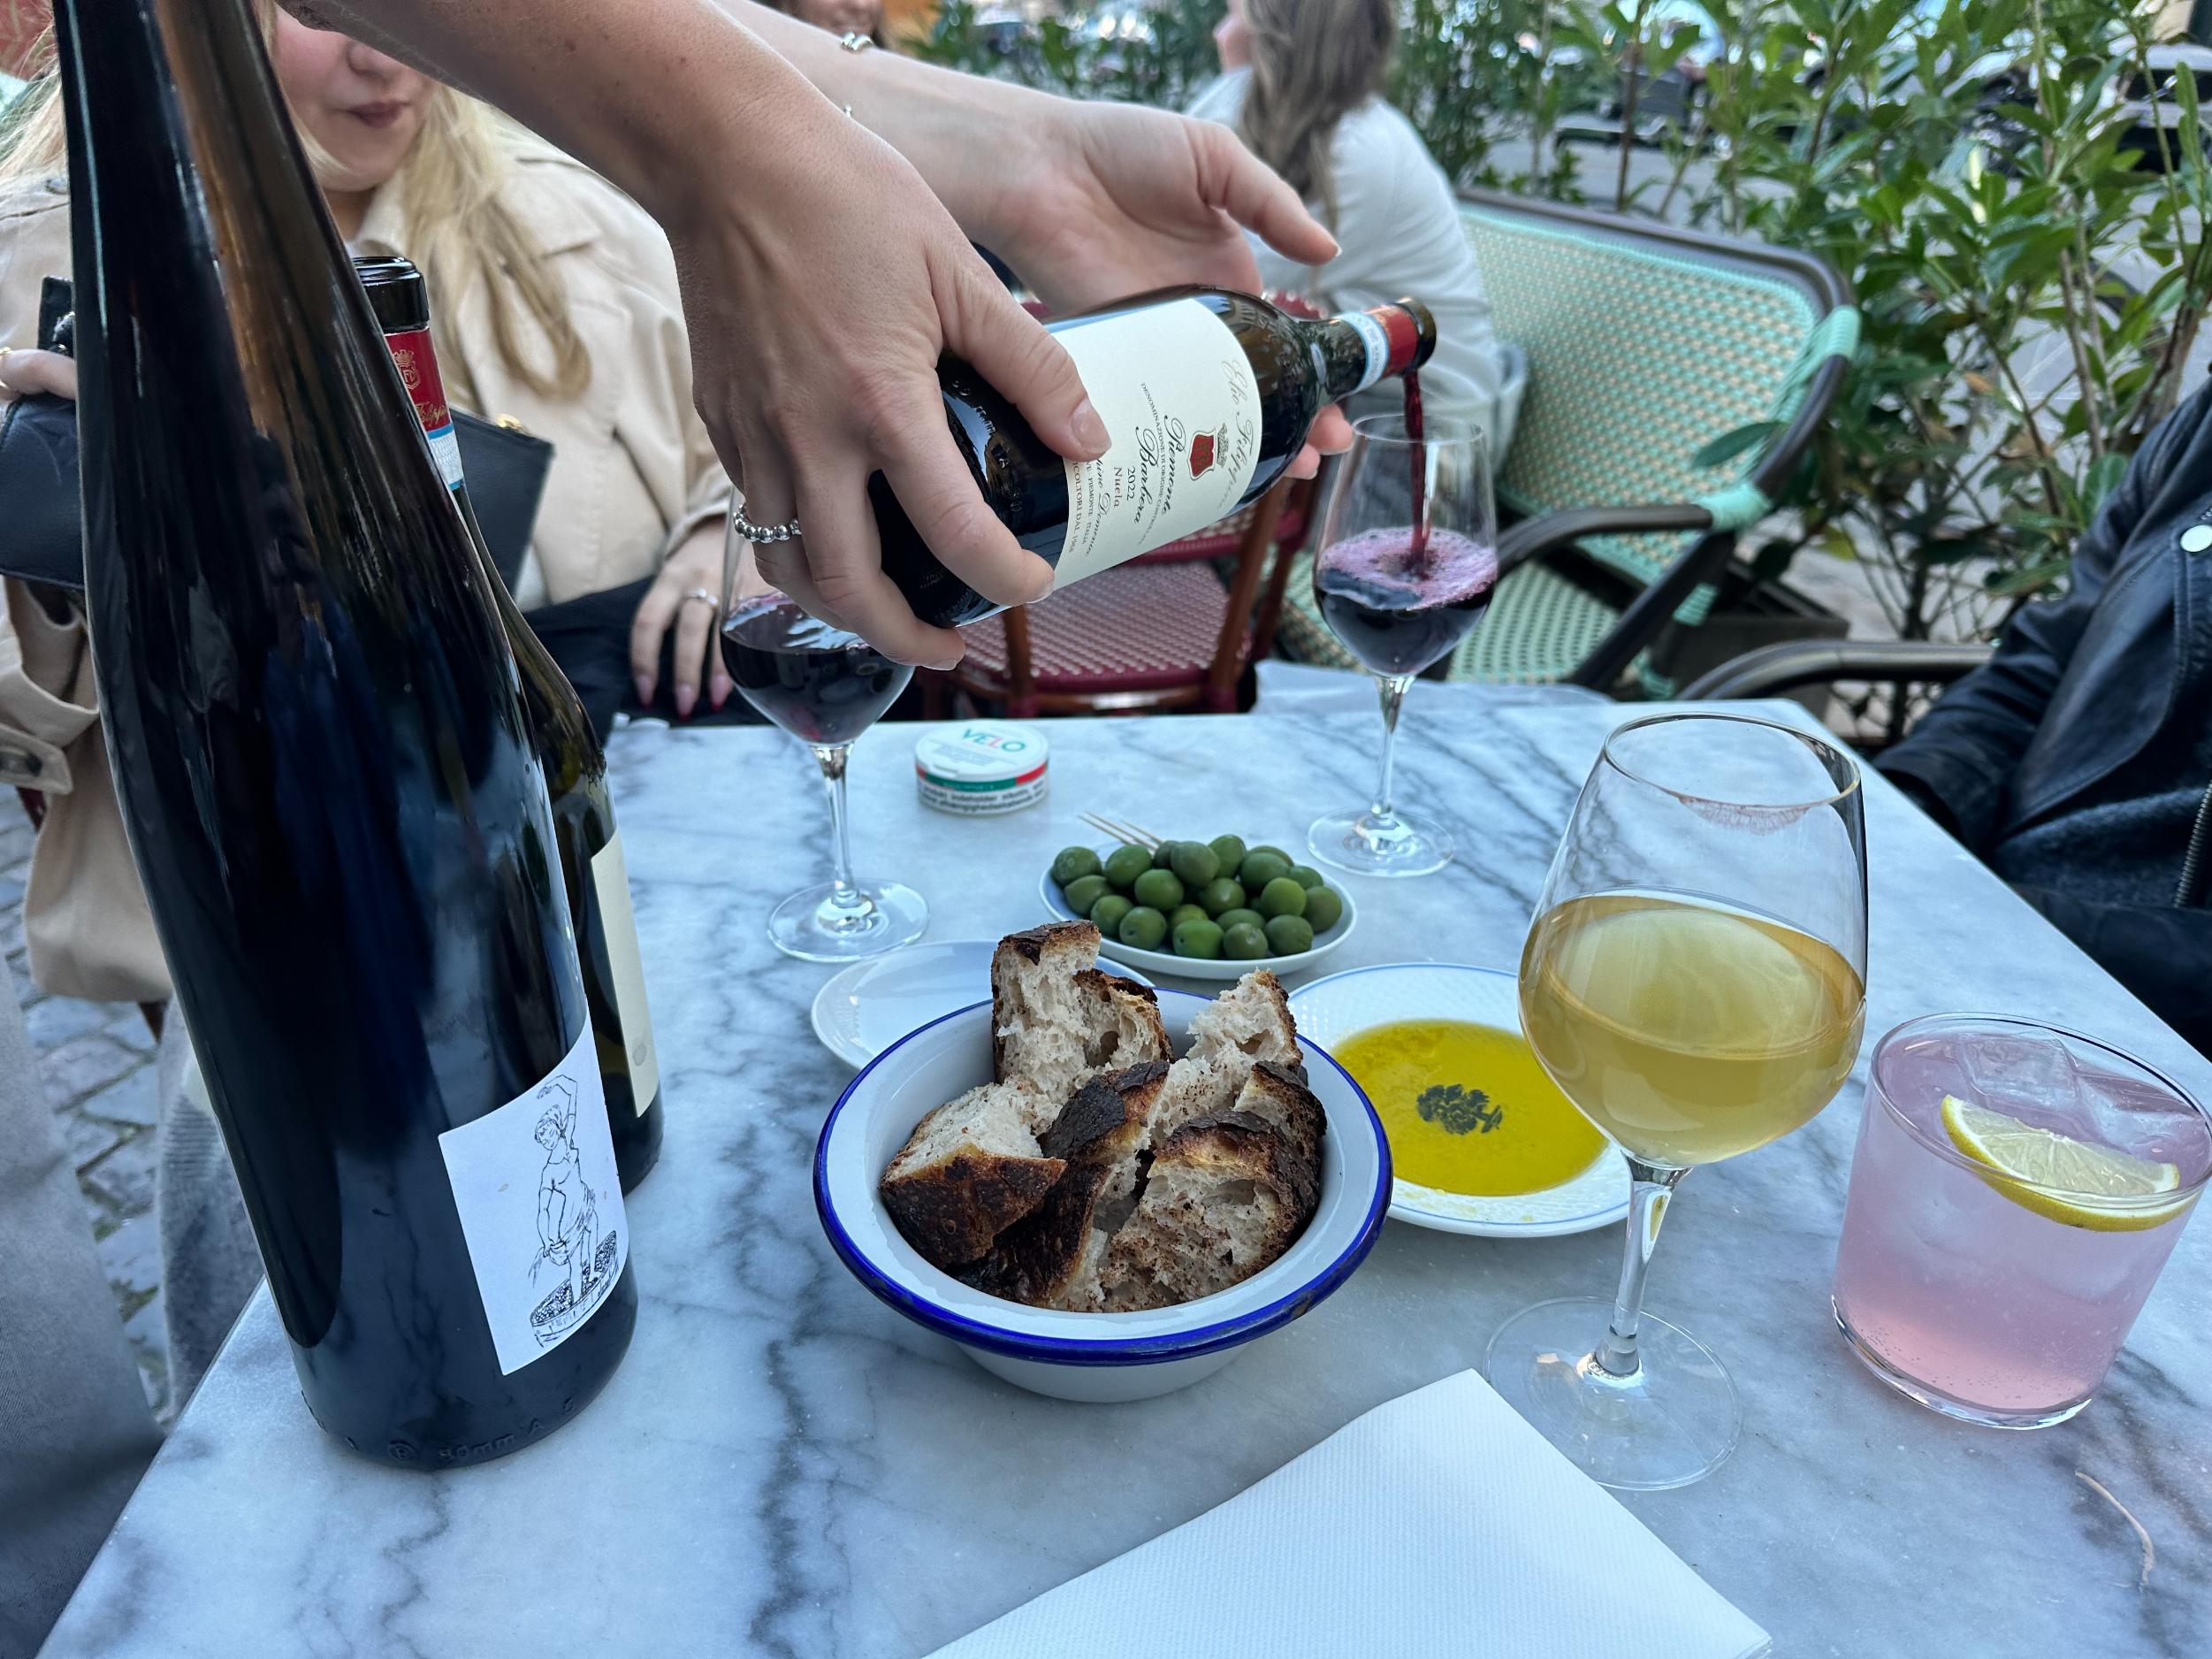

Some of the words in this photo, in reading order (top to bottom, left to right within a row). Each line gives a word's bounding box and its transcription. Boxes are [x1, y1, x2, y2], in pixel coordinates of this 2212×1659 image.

[1140, 383, 1166, 450] DENOMINAZIONE
[1156, 463, 1166, 498] ORIGINE
[1072, 463, 1083, 510] ICOLTORI
[1113, 467, 1123, 508] Nuela
[1126, 467, 1136, 501] 2022
[1134, 426, 1160, 524] Barbera
[1162, 415, 1186, 516] Piemonte
[962, 728, 1026, 753] VELO
